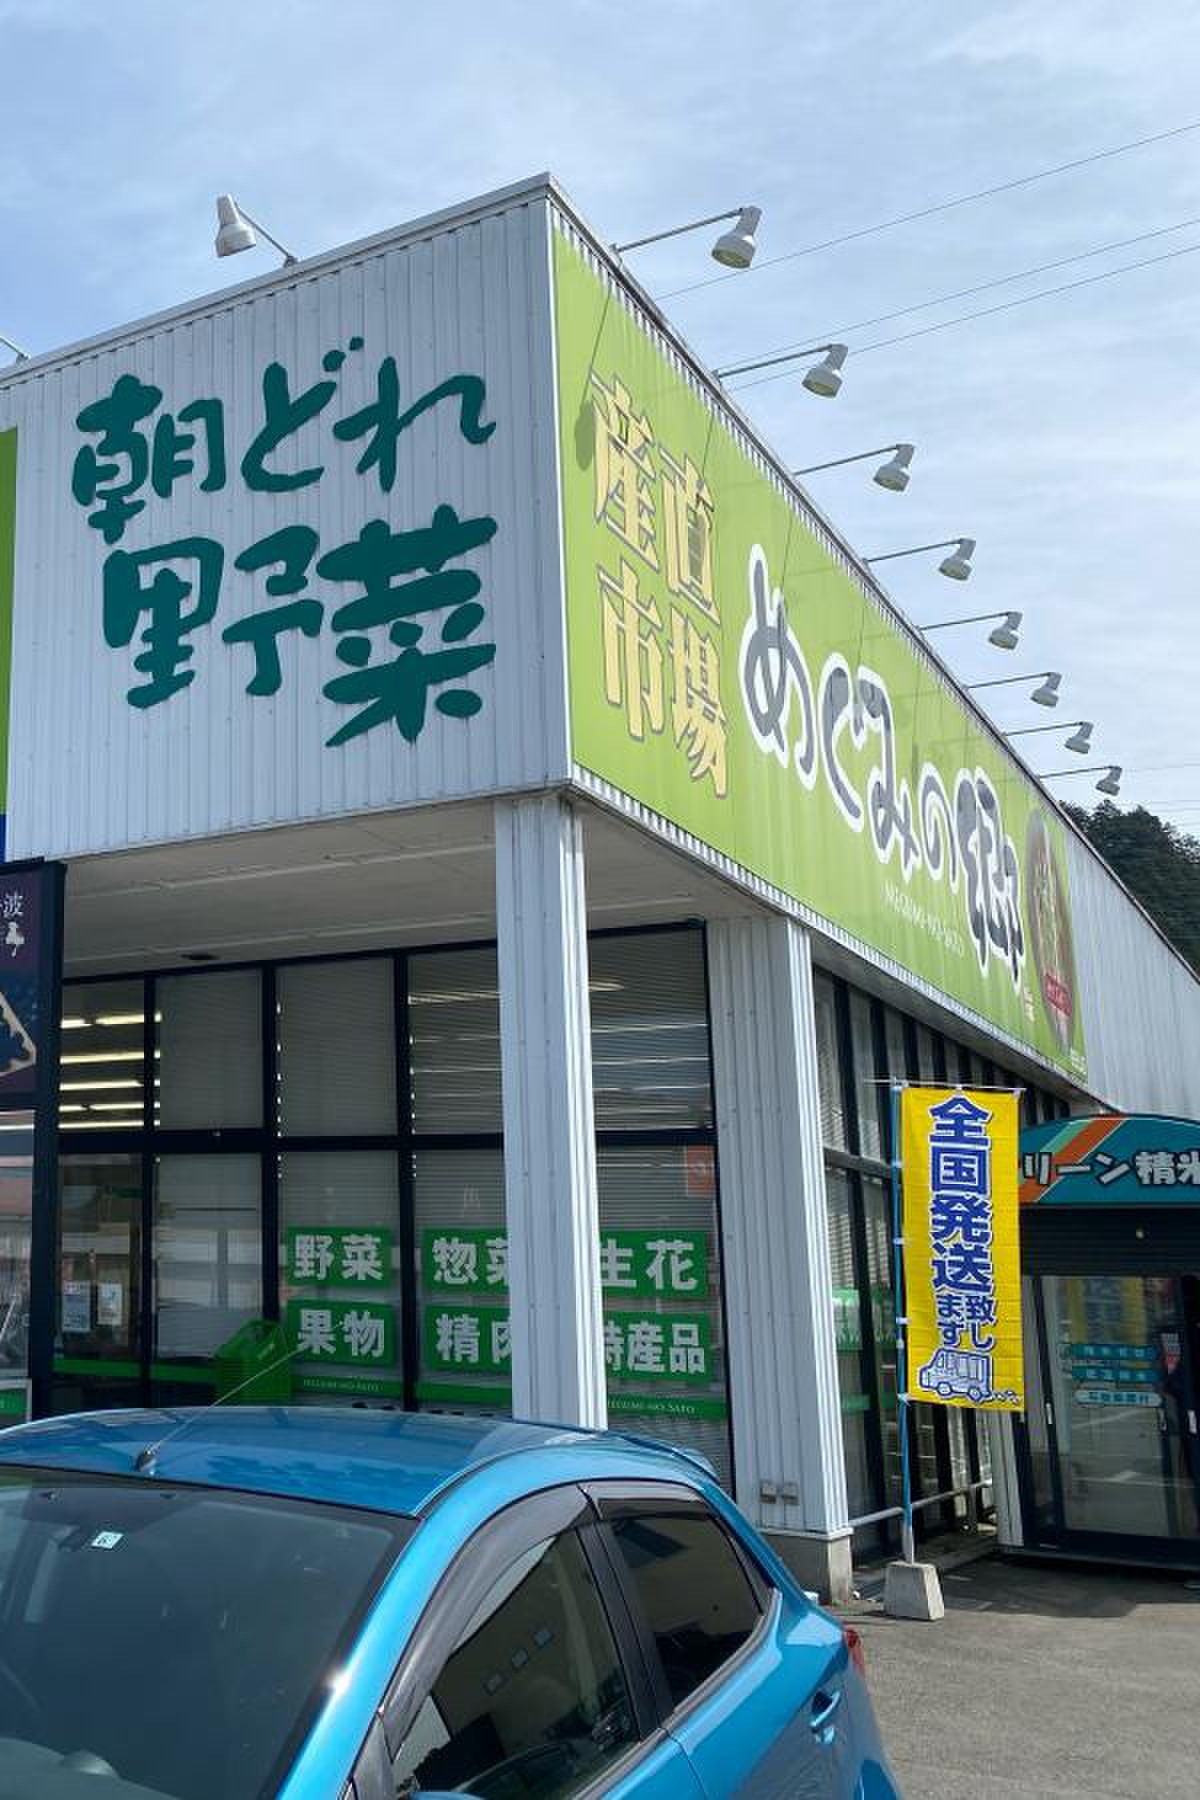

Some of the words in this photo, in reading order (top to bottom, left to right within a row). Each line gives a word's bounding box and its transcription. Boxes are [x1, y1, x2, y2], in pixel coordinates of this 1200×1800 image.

[72, 337, 497, 544] 朝どれ
[590, 371, 720, 626] 産直
[102, 504, 497, 747] 野菜
[597, 563, 728, 798] 市場
[740, 544, 1026, 996] めぐみの郷
[294, 1234, 383, 1280] 野菜
[600, 1238, 698, 1290] 生花
[928, 1094, 993, 1294] 全国発送
[1019, 1152, 1200, 1184] リーン精米
[298, 1309, 385, 1357] 果物
